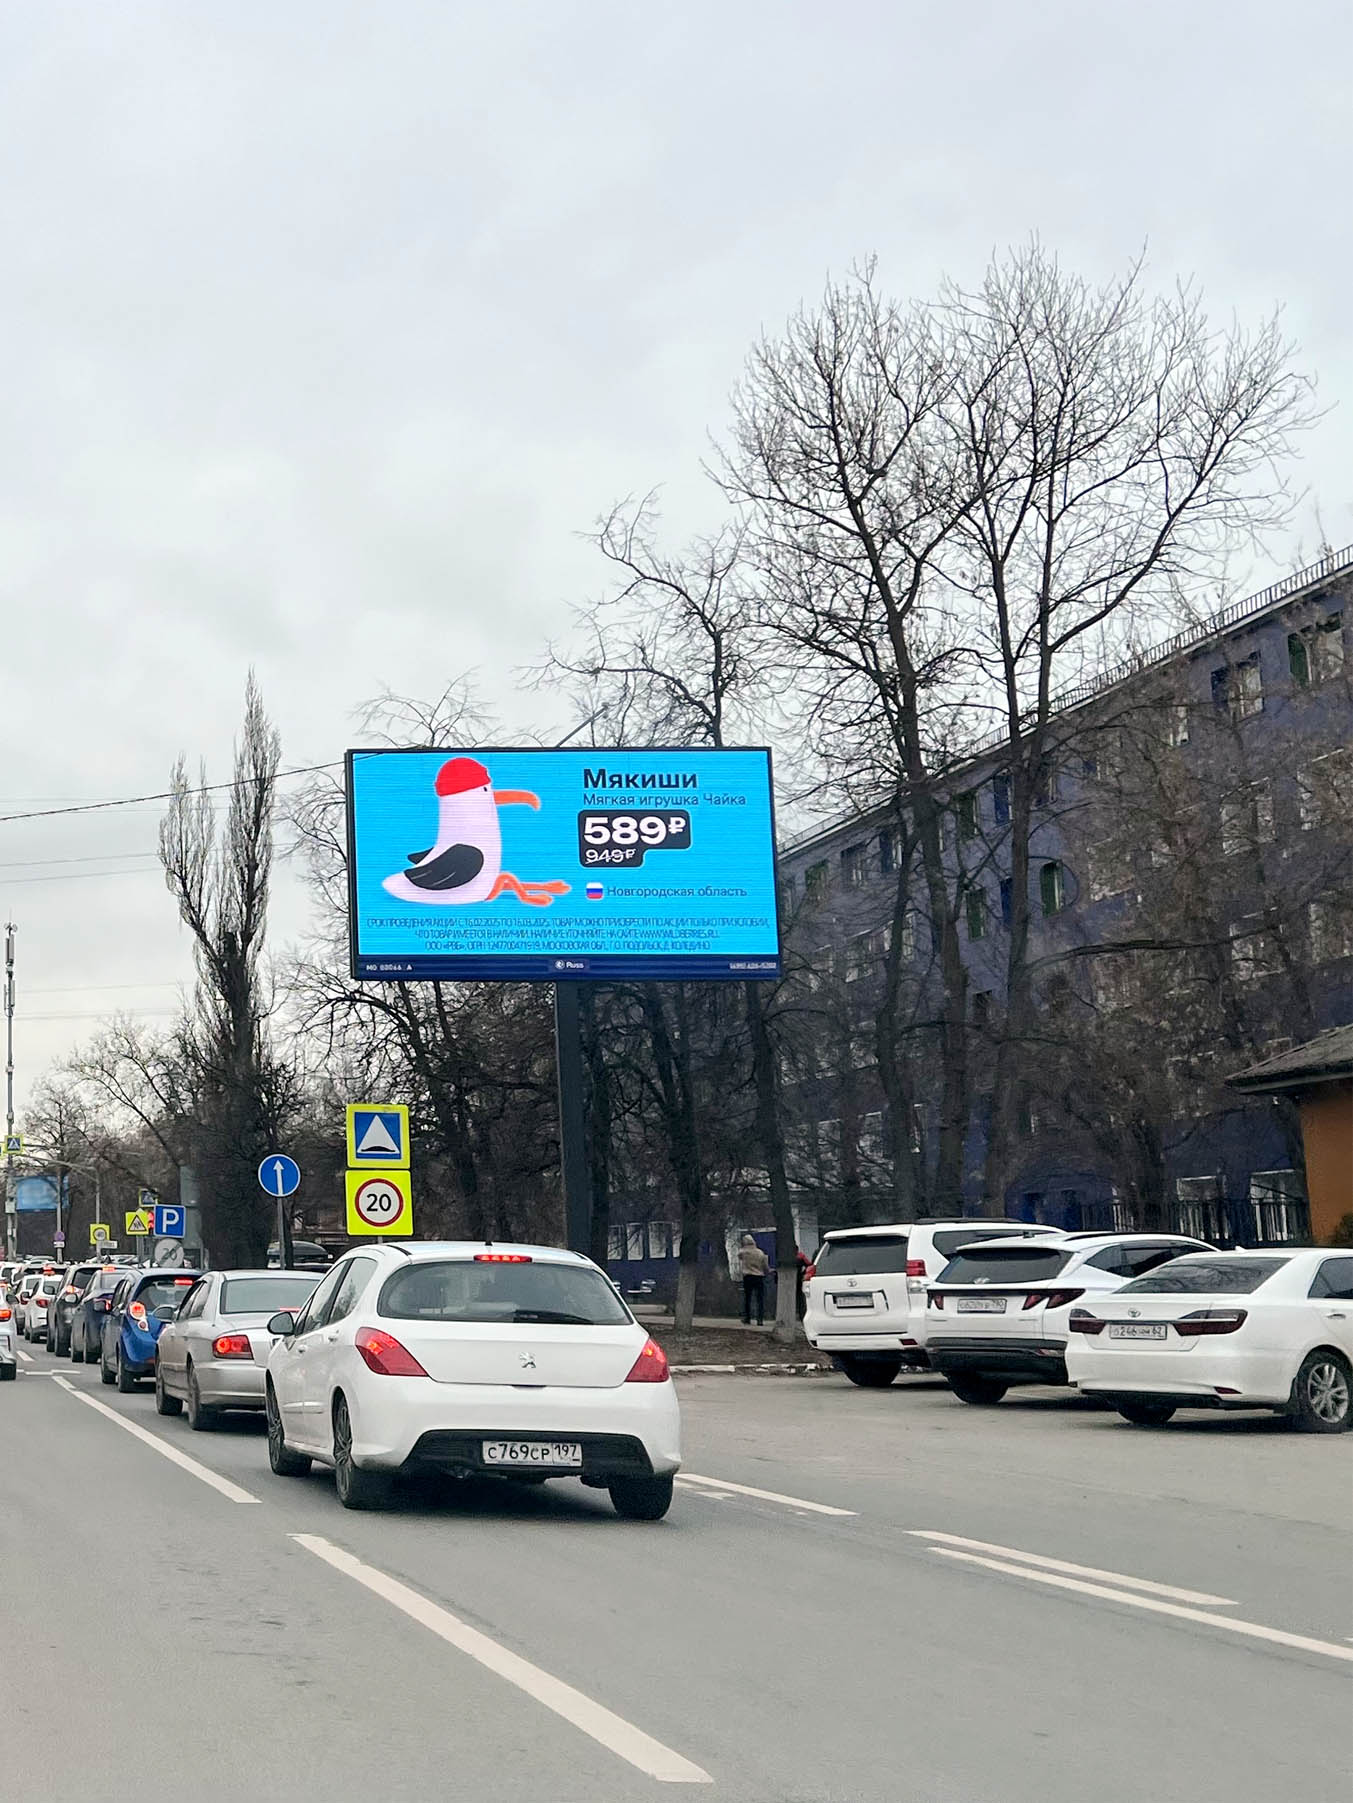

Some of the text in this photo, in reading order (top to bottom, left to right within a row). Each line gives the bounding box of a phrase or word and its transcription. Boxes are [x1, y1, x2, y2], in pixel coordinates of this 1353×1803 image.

[583, 769, 697, 789] Мякиши
[583, 793, 746, 807] Мягкая игрушка Чайка
[607, 885, 747, 898] Новгородская область
[366, 1193, 392, 1212] 20
[162, 1208, 180, 1233] P
[161, 1247, 178, 1260] 20
